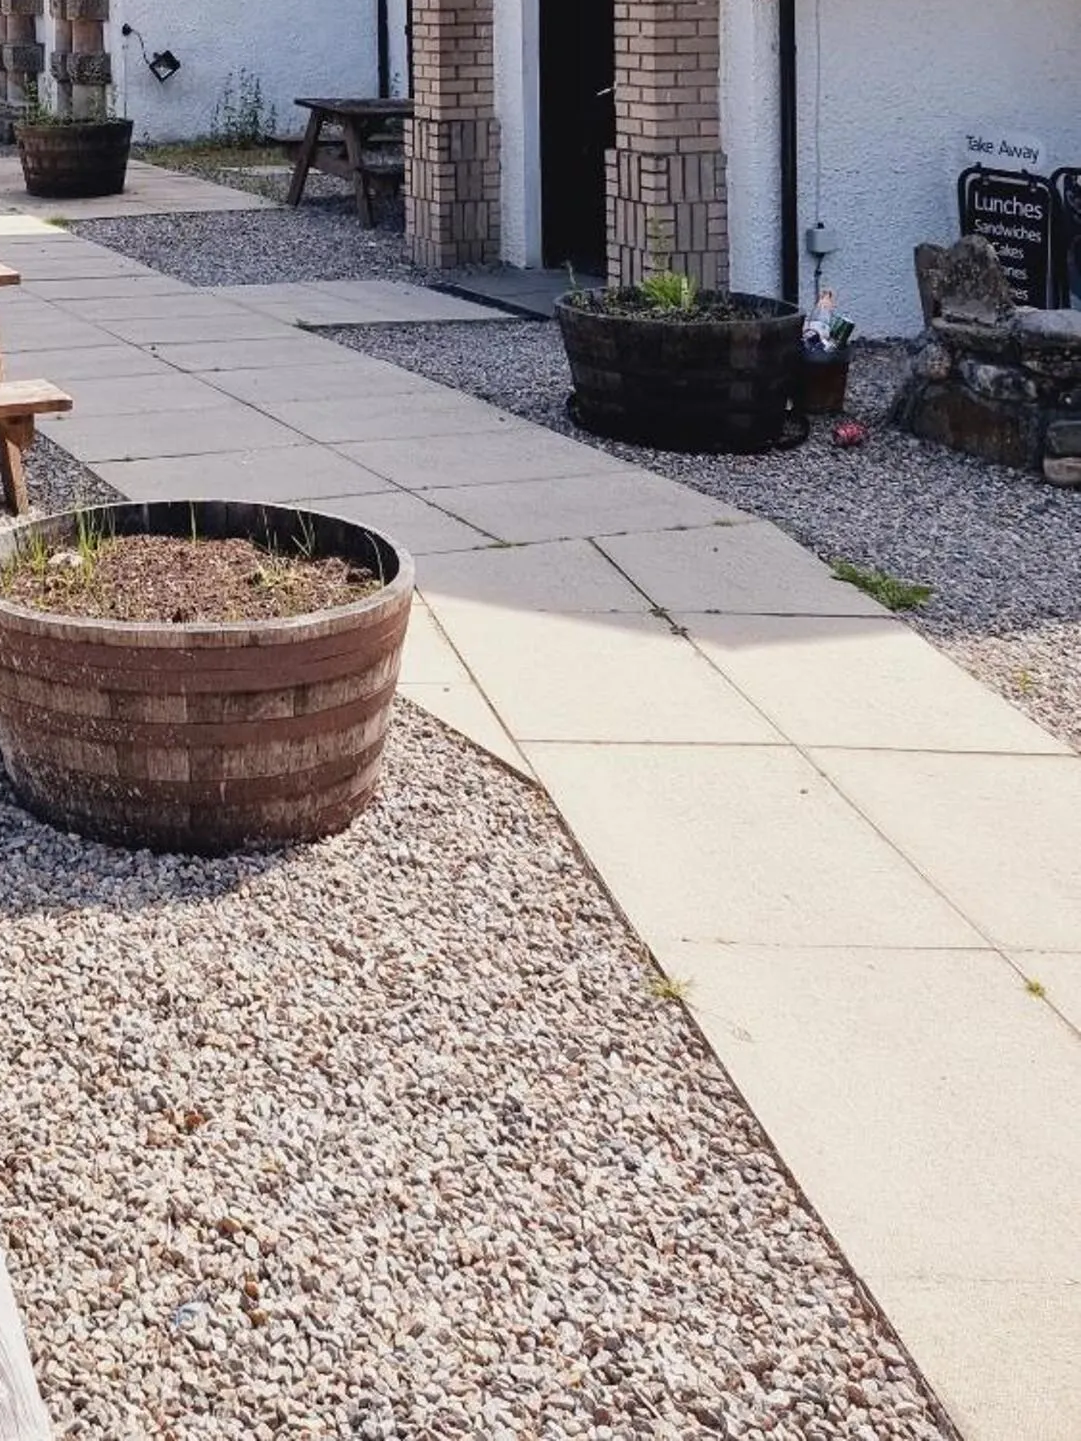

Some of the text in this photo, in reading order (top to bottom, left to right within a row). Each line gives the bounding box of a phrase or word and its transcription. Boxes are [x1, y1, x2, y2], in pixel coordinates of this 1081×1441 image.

[965, 135, 1039, 164] Take Away
[974, 190, 1043, 221] Lunches
[973, 218, 1042, 244] Sandwiches
